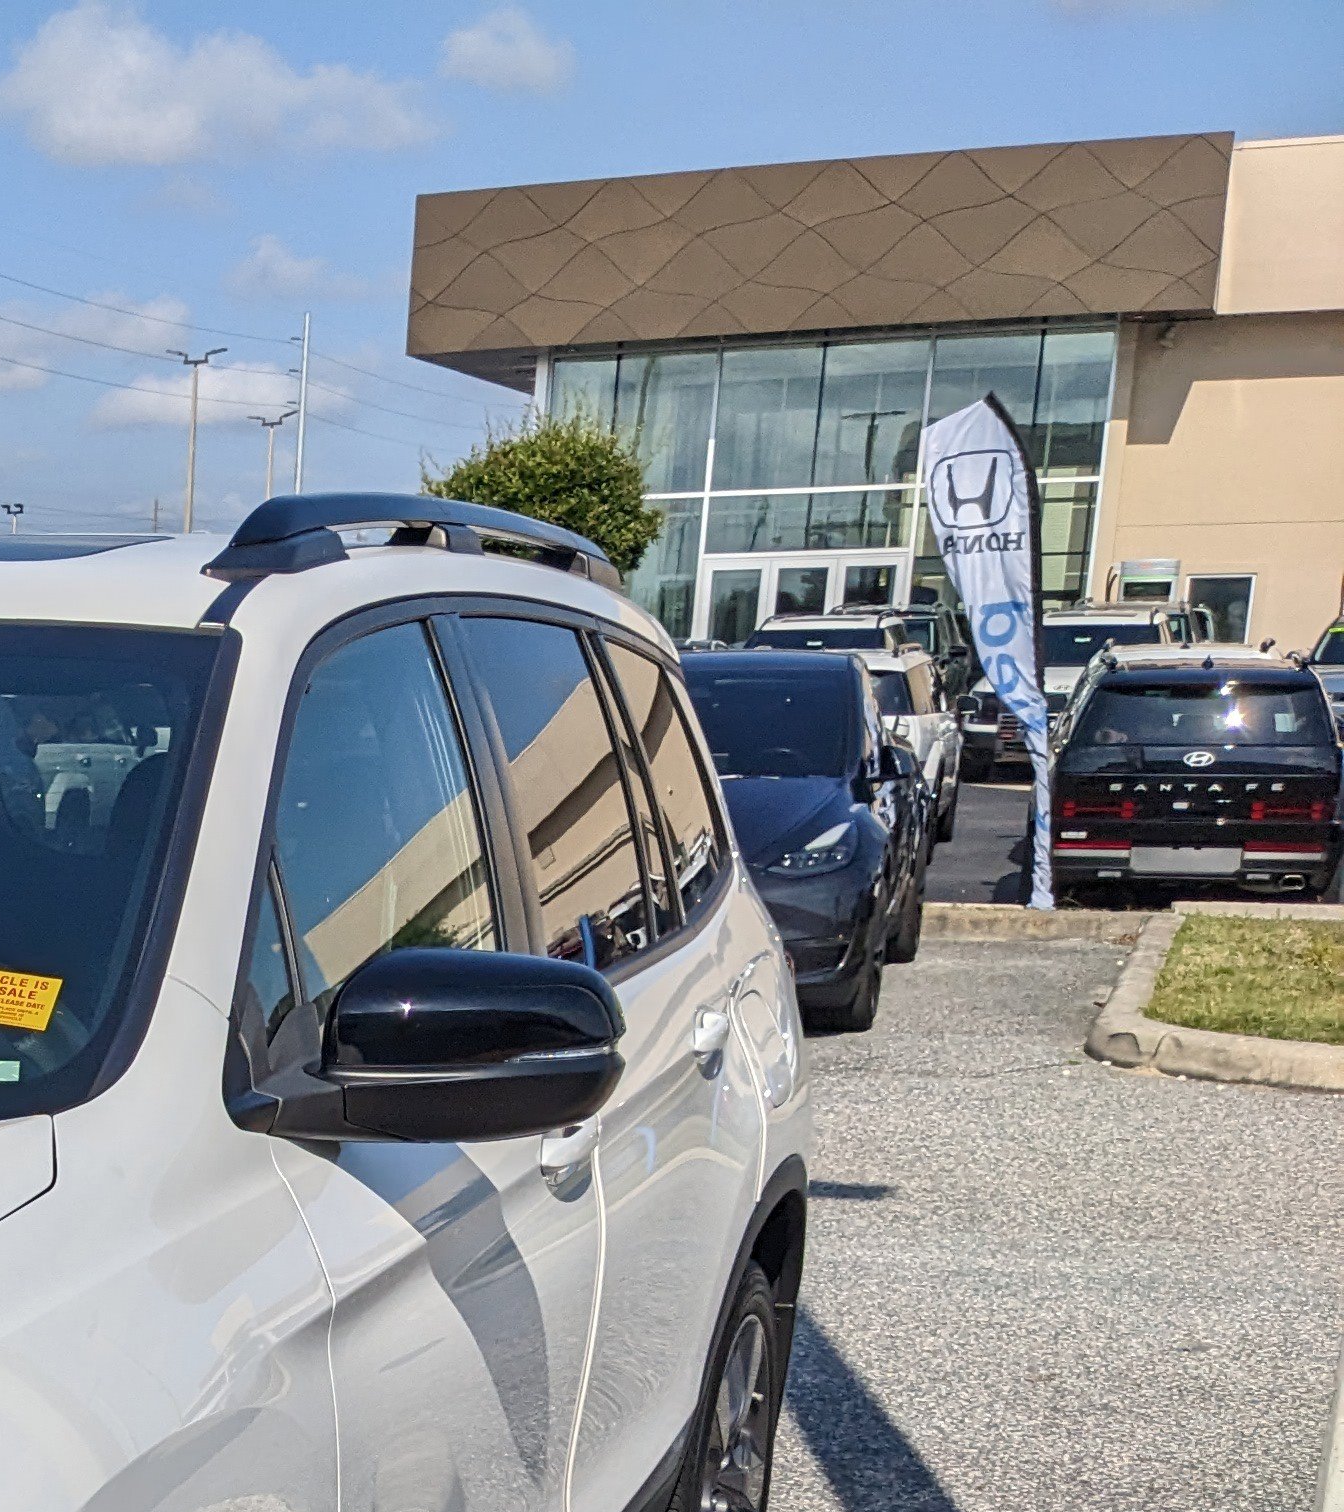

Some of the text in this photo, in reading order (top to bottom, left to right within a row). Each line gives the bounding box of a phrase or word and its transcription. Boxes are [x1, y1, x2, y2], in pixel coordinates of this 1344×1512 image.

[1109, 783, 1286, 792] SANTA FE
[34, 980, 50, 990] IS
[26, 1002, 45, 1010] DATE
